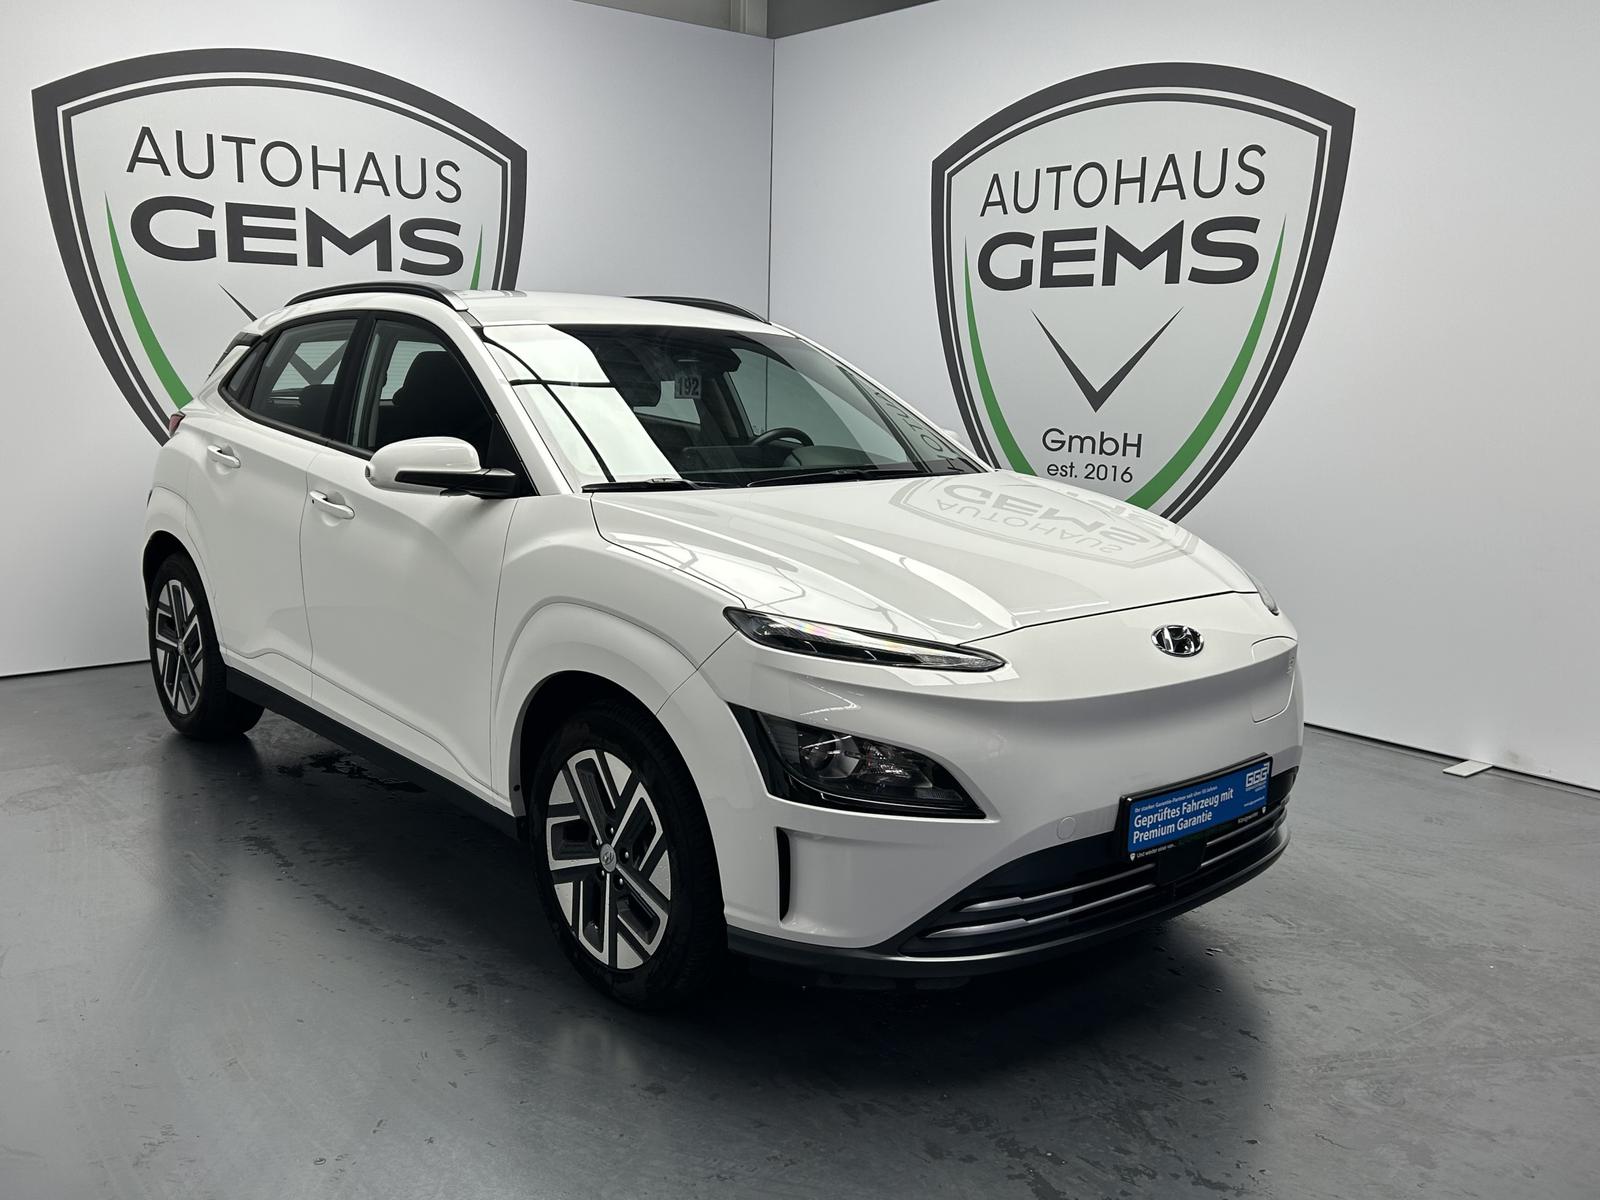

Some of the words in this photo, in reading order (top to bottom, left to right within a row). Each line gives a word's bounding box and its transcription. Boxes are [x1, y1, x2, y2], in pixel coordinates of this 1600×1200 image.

[126, 126, 462, 203] AUTOHAUS
[980, 144, 1266, 217] AUTOHAUS
[130, 195, 464, 276] GEMS
[977, 216, 1260, 291] GEMS
[677, 377, 699, 395] 192
[1042, 428, 1142, 458] GmbH
[1047, 462, 1077, 478] est.
[1084, 463, 1133, 483] 2016
[1245, 766, 1269, 788] GGG
[1133, 823, 1175, 844] Premium
[1177, 810, 1213, 831] Garantie
[1134, 807, 1180, 829] Geprüftes
[1182, 793, 1219, 815] Fahrzeug
[1220, 787, 1234, 802] mit
